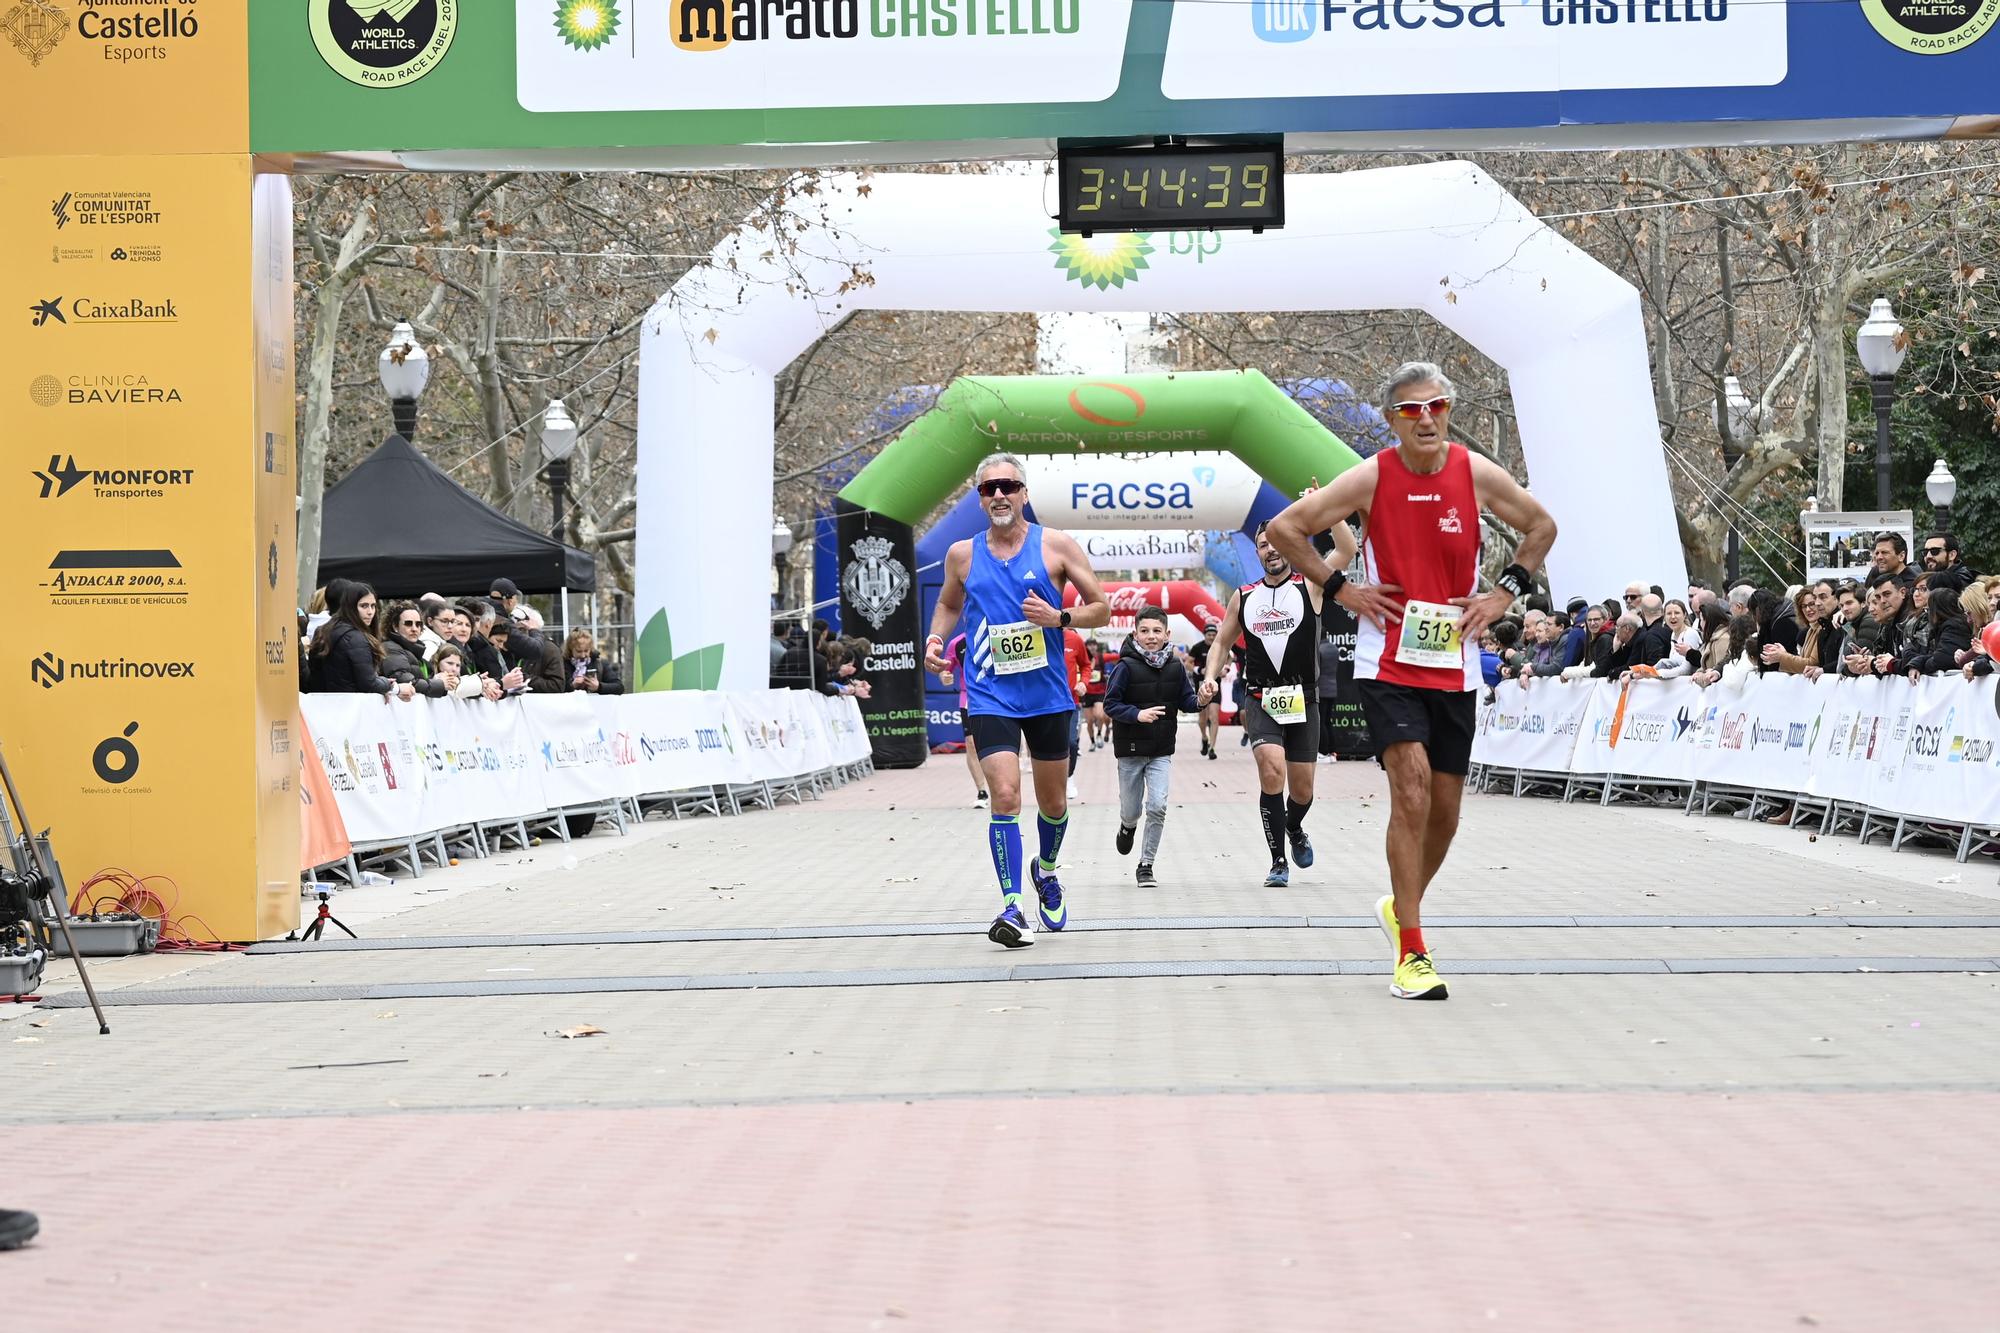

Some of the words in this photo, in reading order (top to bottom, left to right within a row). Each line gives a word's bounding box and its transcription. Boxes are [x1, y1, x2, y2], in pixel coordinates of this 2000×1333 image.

[1323, 0, 1506, 31] Facsa
[1900, 5, 1966, 16] ATHLETICS
[78, 8, 198, 39] Castelló
[361, 28, 405, 38] WORLD
[1911, 37, 1945, 48] ROAD
[1948, 24, 1979, 46] RACE
[351, 38, 416, 50] ATHLETICS
[104, 45, 166, 63] Esports
[361, 70, 395, 82] ROAD
[398, 57, 428, 80] RACE
[426, 26, 450, 61] LABEL
[1077, 165, 1269, 211] 3:44:39
[74, 200, 151, 211] COMUNITAT
[80, 213, 97, 224] DE
[100, 212, 161, 224] L'ESPORT
[73, 298, 178, 319] CaixaBank
[68, 388, 182, 403] BAVIERA
[1107, 429, 1208, 441] D'ESPORTS
[93, 469, 194, 485] MONFORT
[94, 488, 164, 499] Transportes
[1072, 482, 1193, 510] Facsa
[1087, 533, 1197, 557] CaixaBank
[52, 571, 125, 591] ANDACAR
[128, 575, 164, 587] 2000,
[167, 577, 187, 586] S.A.
[52, 598, 90, 606] ALQUILER
[130, 597, 141, 605] DE
[1417, 620, 1452, 643] 513
[1001, 634, 1034, 655] 662
[863, 654, 916, 672] Castelló
[1007, 652, 1031, 661] ANGEL
[70, 658, 195, 678] nutrinovex
[1270, 696, 1294, 710] 867
[123, 786, 152, 794] Castelló
